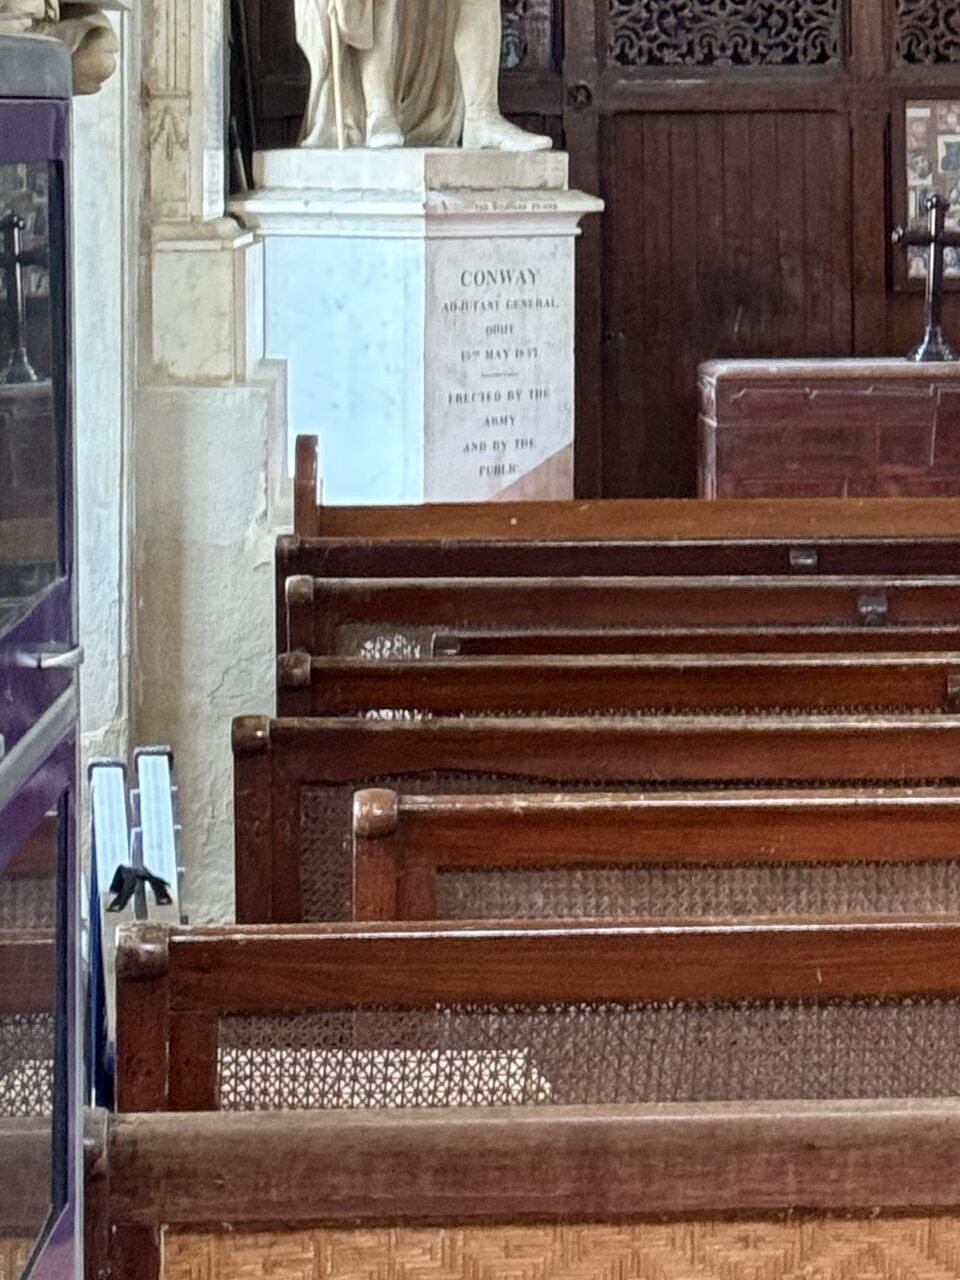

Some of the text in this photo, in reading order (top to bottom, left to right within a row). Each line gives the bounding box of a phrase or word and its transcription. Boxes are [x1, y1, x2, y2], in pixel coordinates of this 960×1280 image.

[460, 268, 541, 288] CONWAY
[441, 299, 500, 314] ADJUTANT
[485, 347, 511, 360] MAY
[448, 387, 550, 405] ERECTED BY THE
[483, 414, 516, 427] ARMY
[462, 437, 536, 454] AND BY THE
[478, 463, 518, 477] PUBLIC
